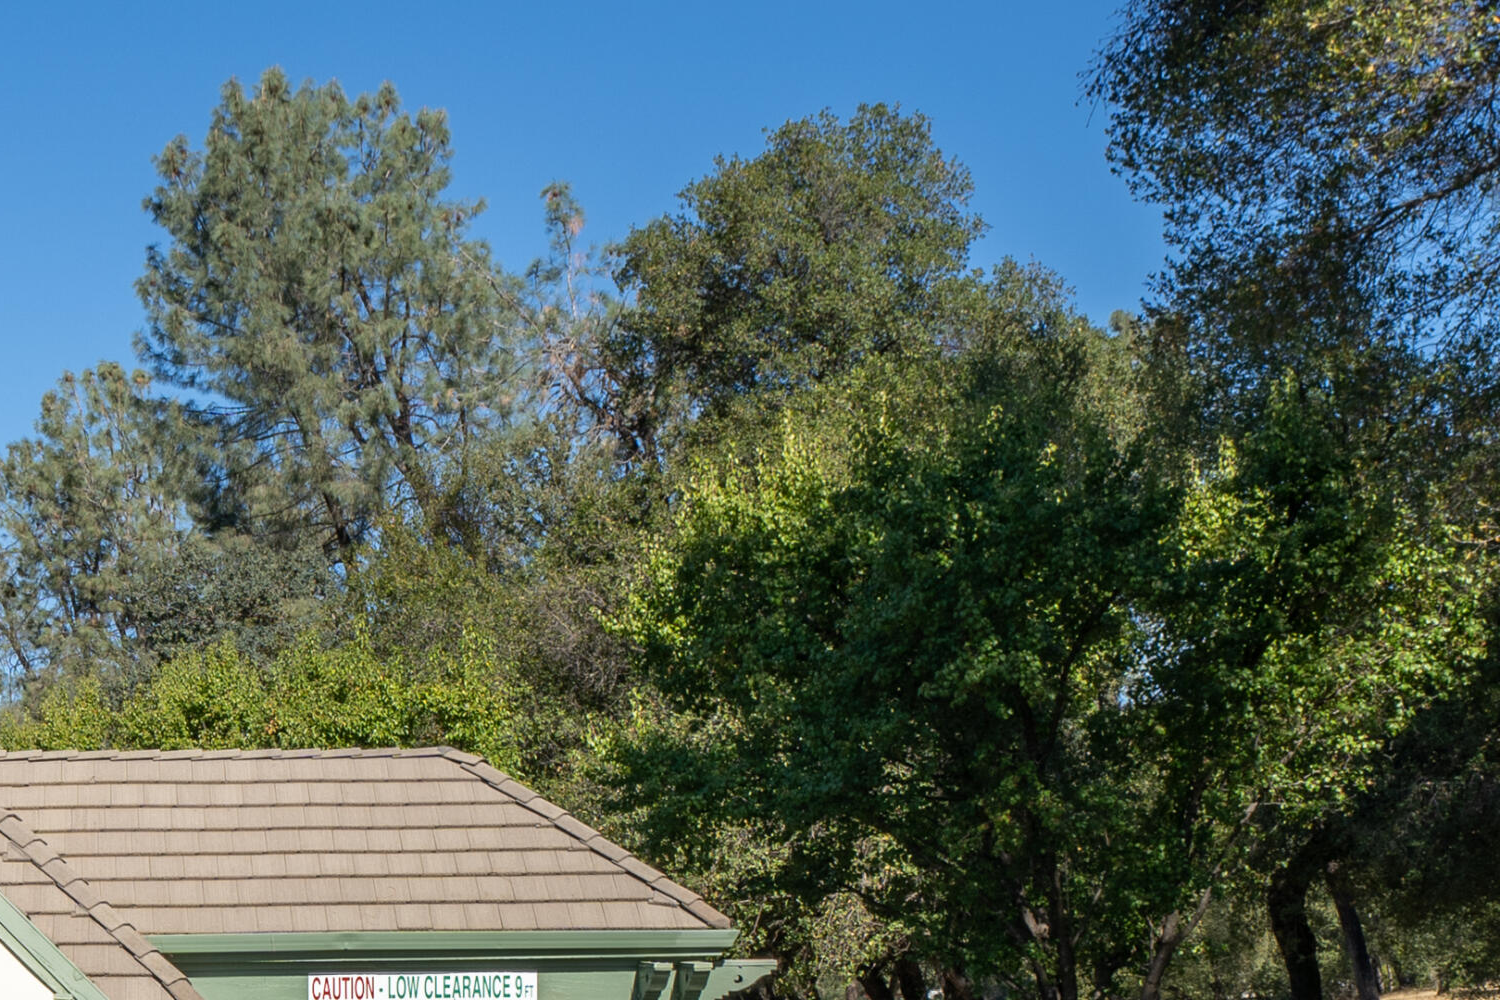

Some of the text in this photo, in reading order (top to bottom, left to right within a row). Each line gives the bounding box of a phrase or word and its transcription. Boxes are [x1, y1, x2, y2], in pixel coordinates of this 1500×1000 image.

[312, 976, 375, 1000] CAUTION
[388, 976, 419, 999] LOW
[424, 975, 510, 999] CLEARANCE
[515, 975, 523, 998] 9
[525, 985, 534, 998] FT
